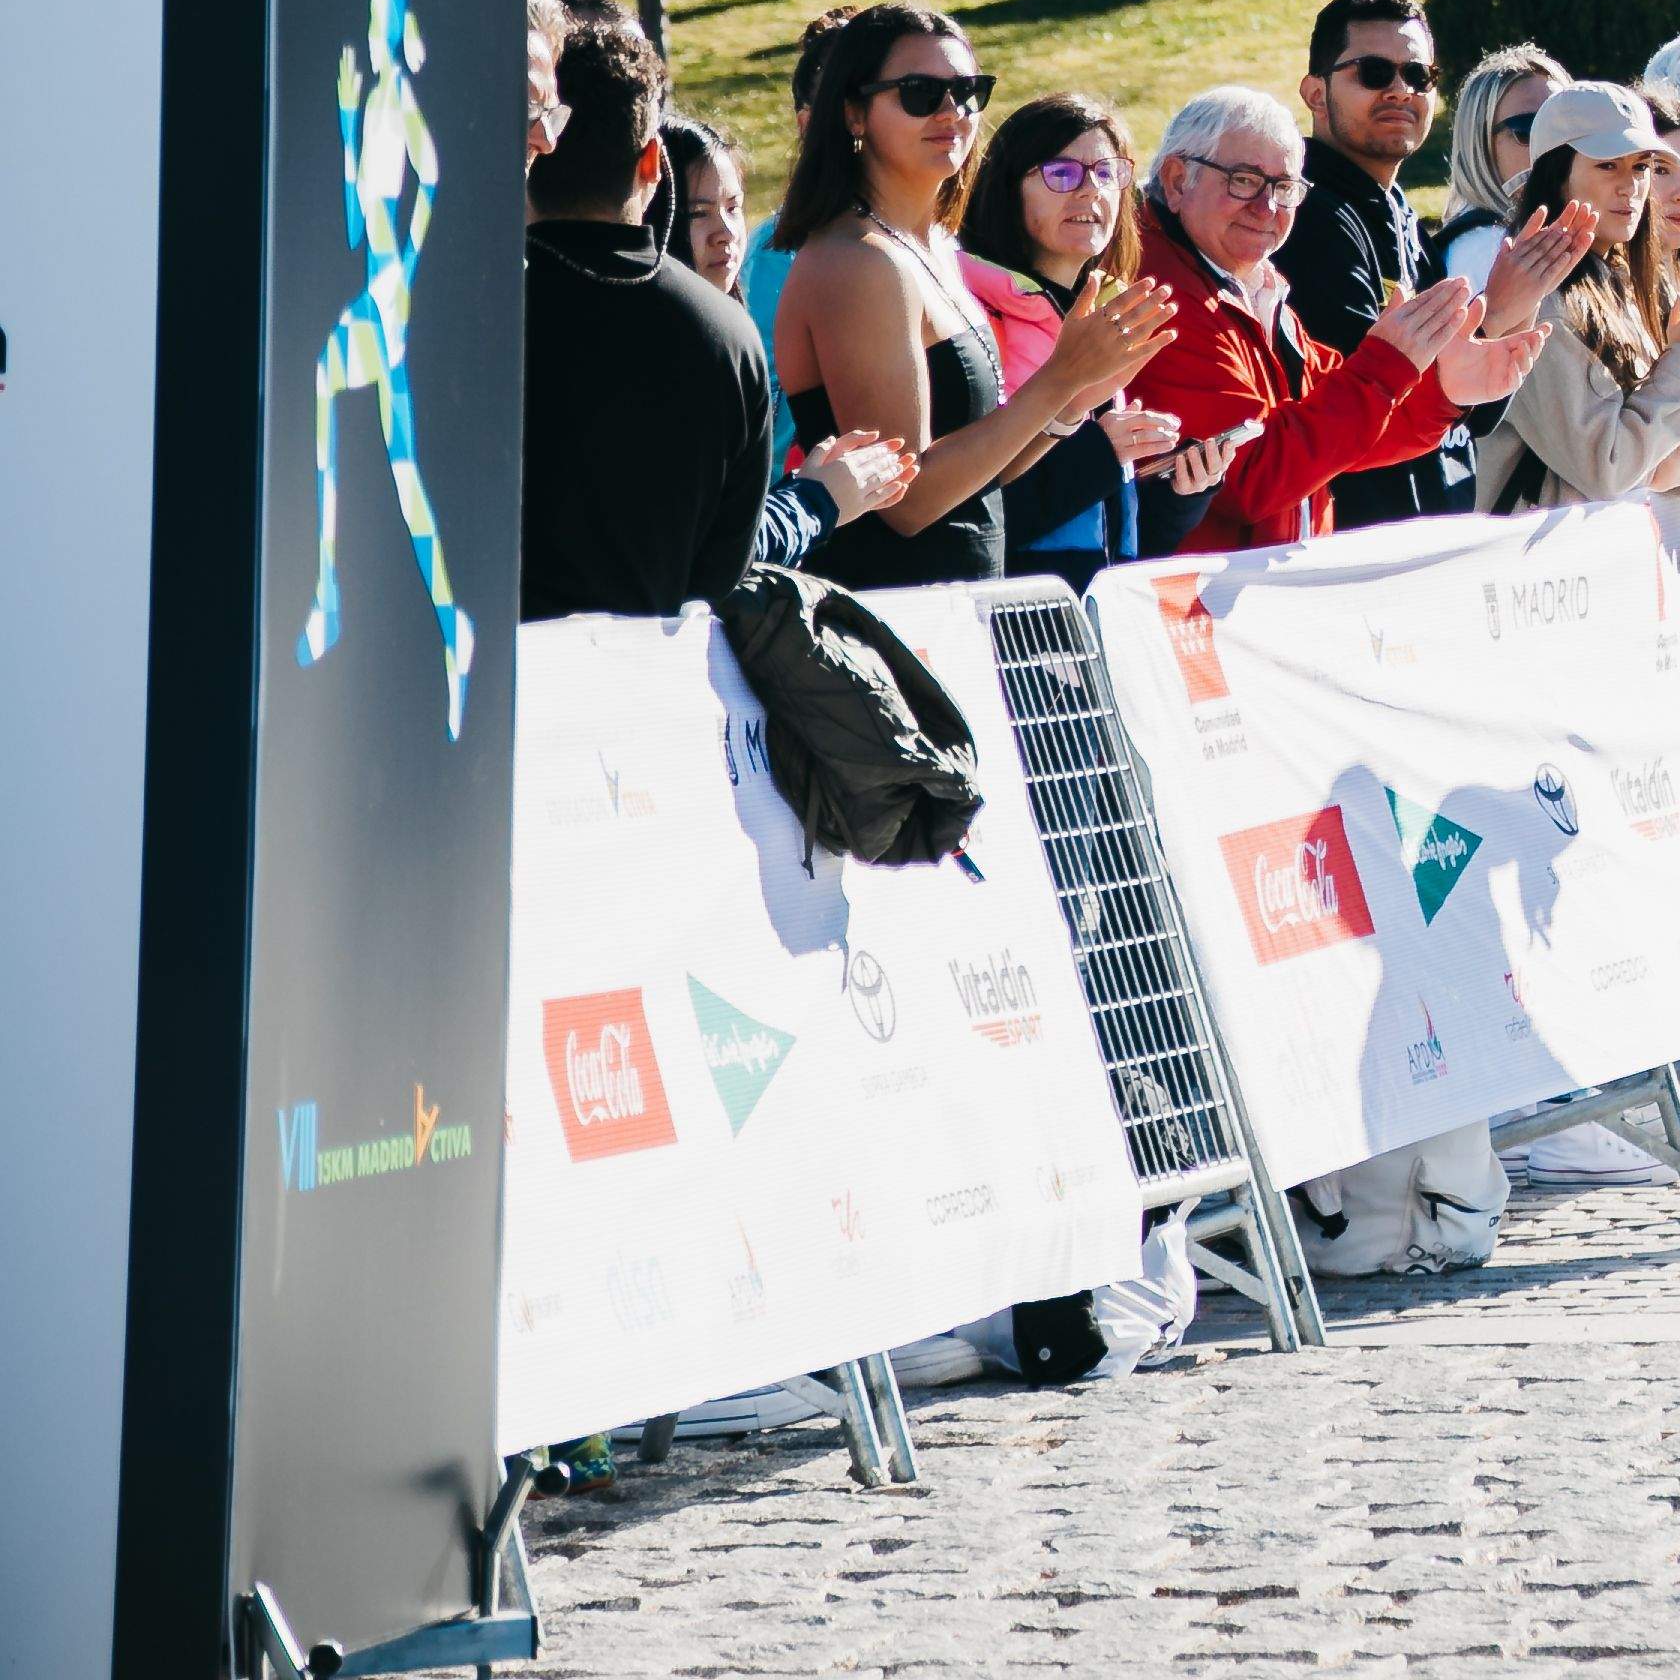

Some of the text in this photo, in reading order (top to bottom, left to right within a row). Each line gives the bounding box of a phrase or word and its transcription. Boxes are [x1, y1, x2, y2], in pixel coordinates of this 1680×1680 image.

[1511, 576, 1590, 629] MADRID
[317, 1146, 354, 1187] 15KM
[357, 1134, 415, 1177] MADRID
